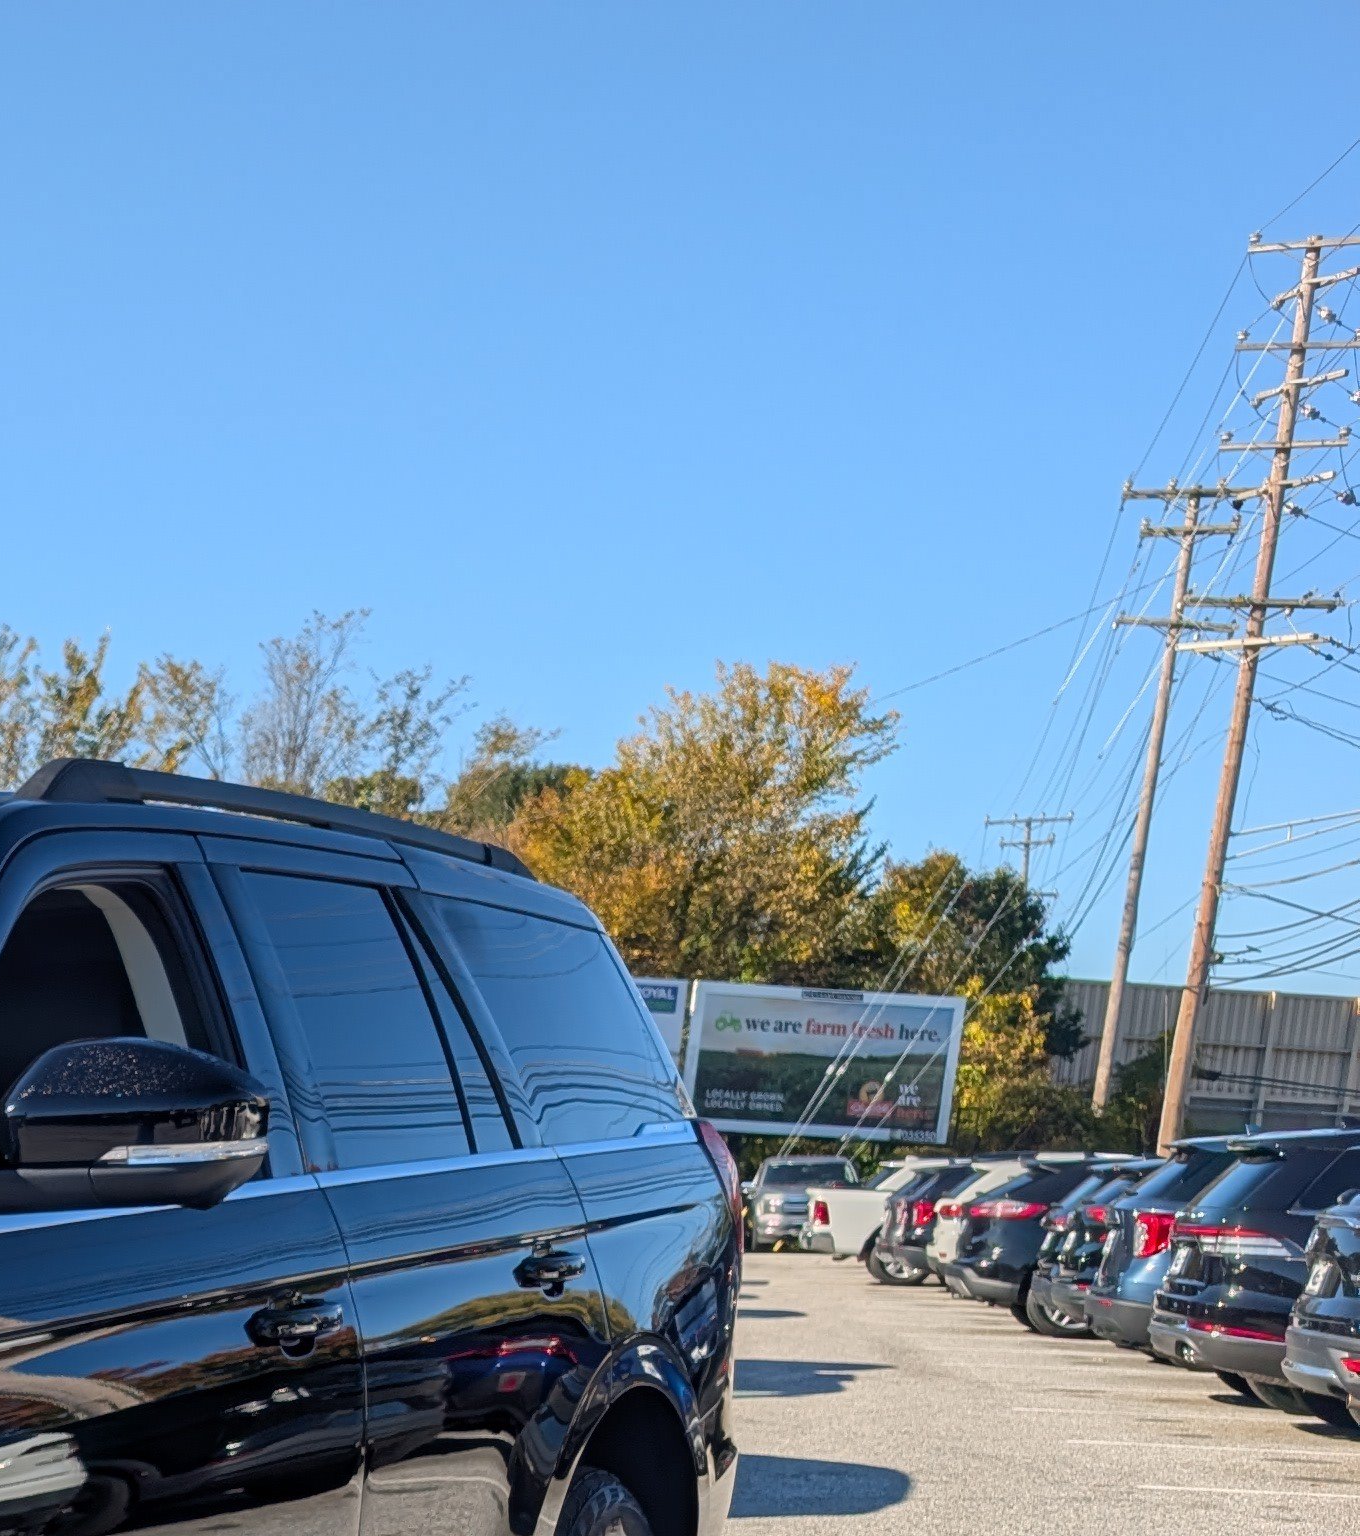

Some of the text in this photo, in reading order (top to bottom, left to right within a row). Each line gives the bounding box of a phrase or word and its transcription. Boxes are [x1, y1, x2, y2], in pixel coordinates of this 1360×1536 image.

[639, 986, 675, 1000] OYAL
[745, 1018, 770, 1032] we
[773, 1019, 802, 1034] are
[805, 1017, 847, 1036] farm
